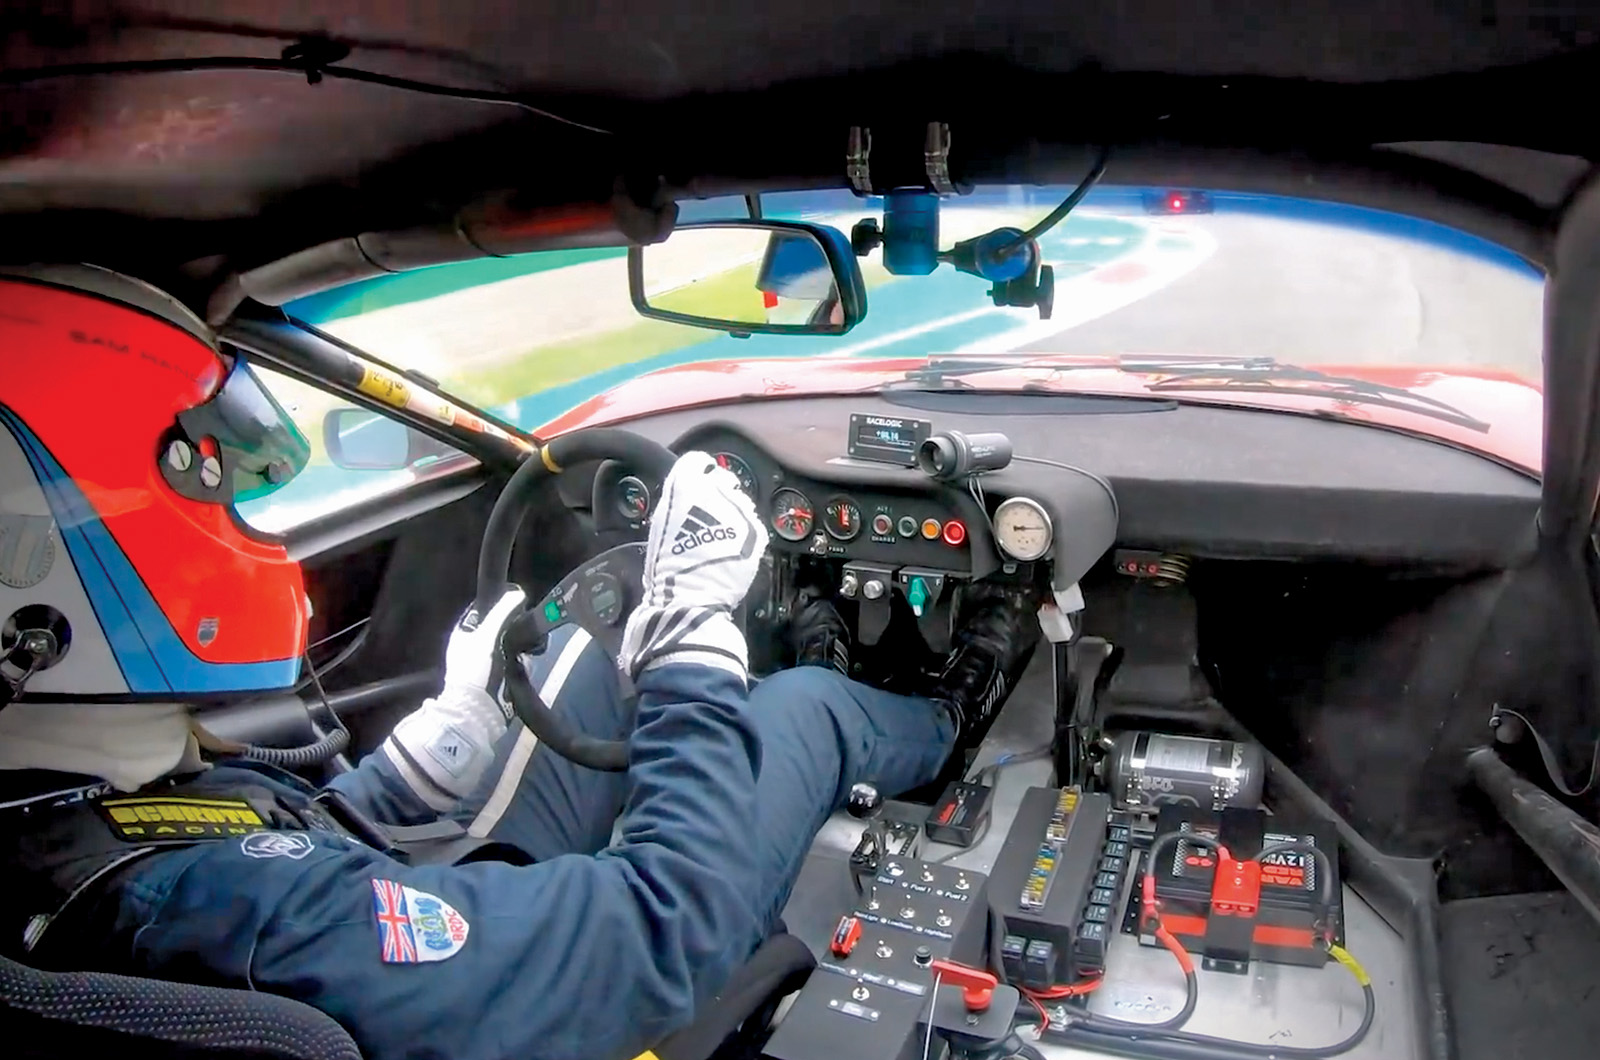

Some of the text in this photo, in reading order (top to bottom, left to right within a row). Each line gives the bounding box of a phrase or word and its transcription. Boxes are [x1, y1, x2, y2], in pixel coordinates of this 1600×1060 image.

[866, 417, 902, 428] RACELOGIC
[671, 527, 737, 556] adidas
[910, 883, 926, 892] Fuel
[944, 891, 961, 900] Fuel
[445, 909, 466, 942] BRDC
